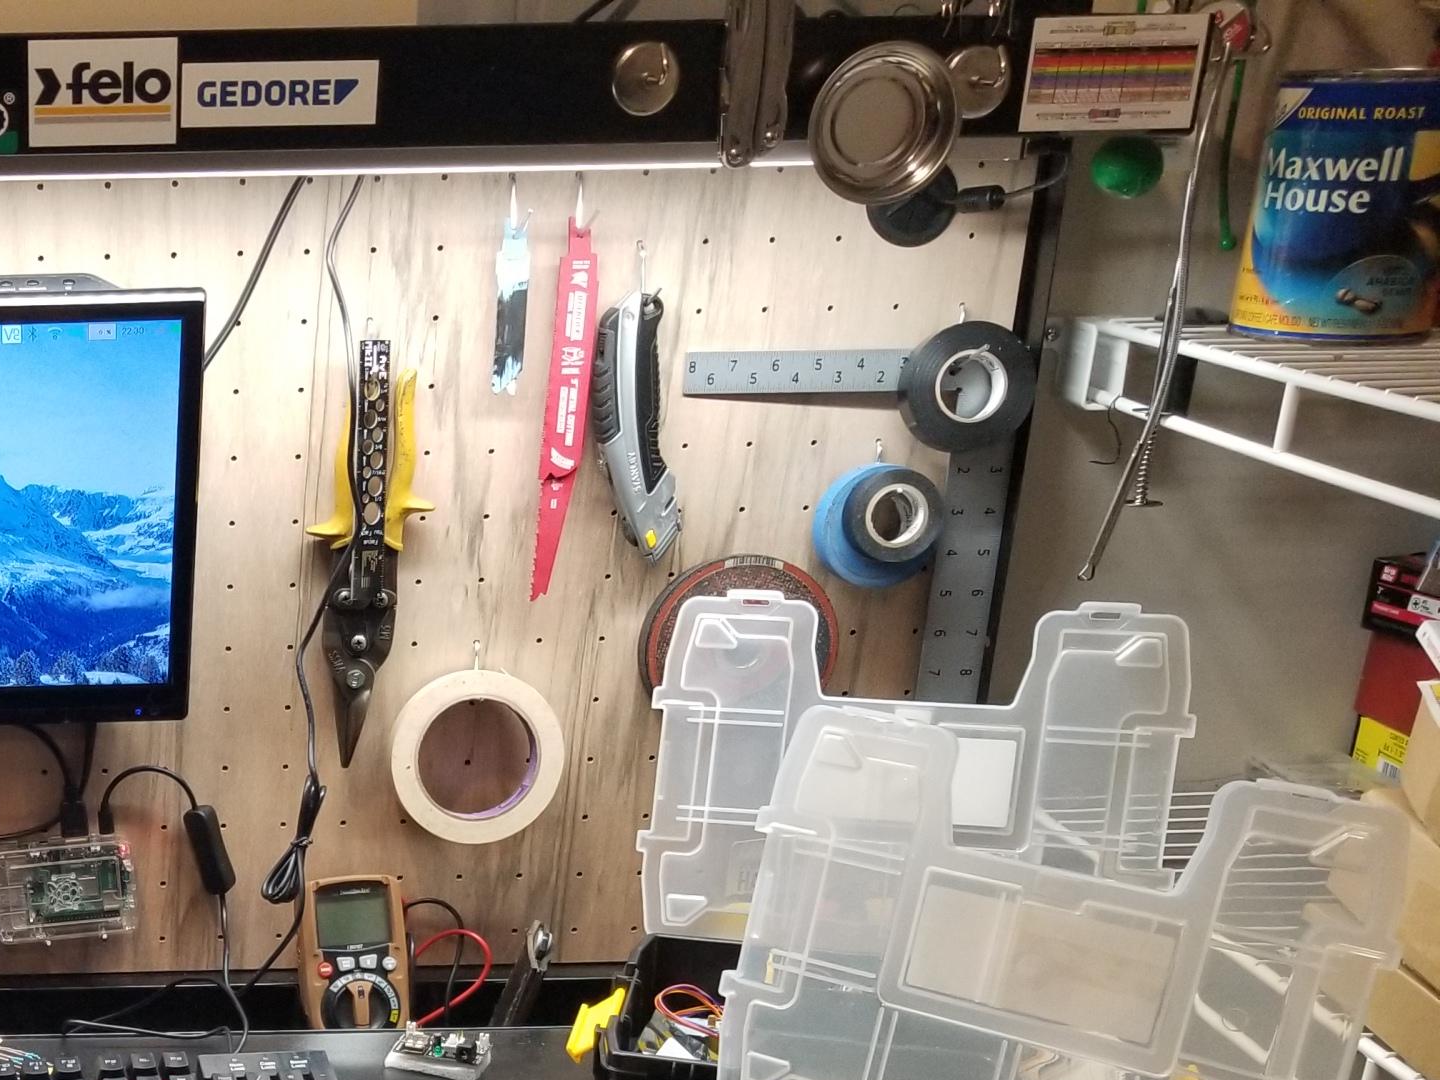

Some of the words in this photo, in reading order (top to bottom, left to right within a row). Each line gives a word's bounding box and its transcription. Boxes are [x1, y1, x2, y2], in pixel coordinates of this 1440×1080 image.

[66, 61, 171, 106] felo
[196, 79, 334, 109] GEDORE
[1298, 106, 1367, 120] ORIGINAL
[1372, 106, 1426, 120] ROAST
[1268, 146, 1405, 182] Maxwell
[1264, 181, 1371, 214] House
[689, 361, 696, 373] 8
[729, 360, 737, 372] 7
[772, 360, 780, 371] 6
[814, 358, 822, 370] 5
[857, 358, 865, 370] 4
[707, 373, 714, 385] 6
[749, 373, 757, 384] 5
[791, 372, 799, 384] 4
[834, 371, 842, 383] 3
[876, 371, 885, 383] 2
[956, 466, 971, 475] 2
[990, 466, 1002, 474] 3
[951, 508, 964, 517] 3
[984, 507, 996, 516] 4
[945, 549, 958, 557] 4
[978, 549, 990, 557] 5
[940, 589, 952, 597] 5
[971, 589, 984, 597] 6
[934, 629, 946, 637] 6
[966, 629, 978, 637] 7
[928, 669, 941, 677] 7
[960, 668, 972, 677] 8
